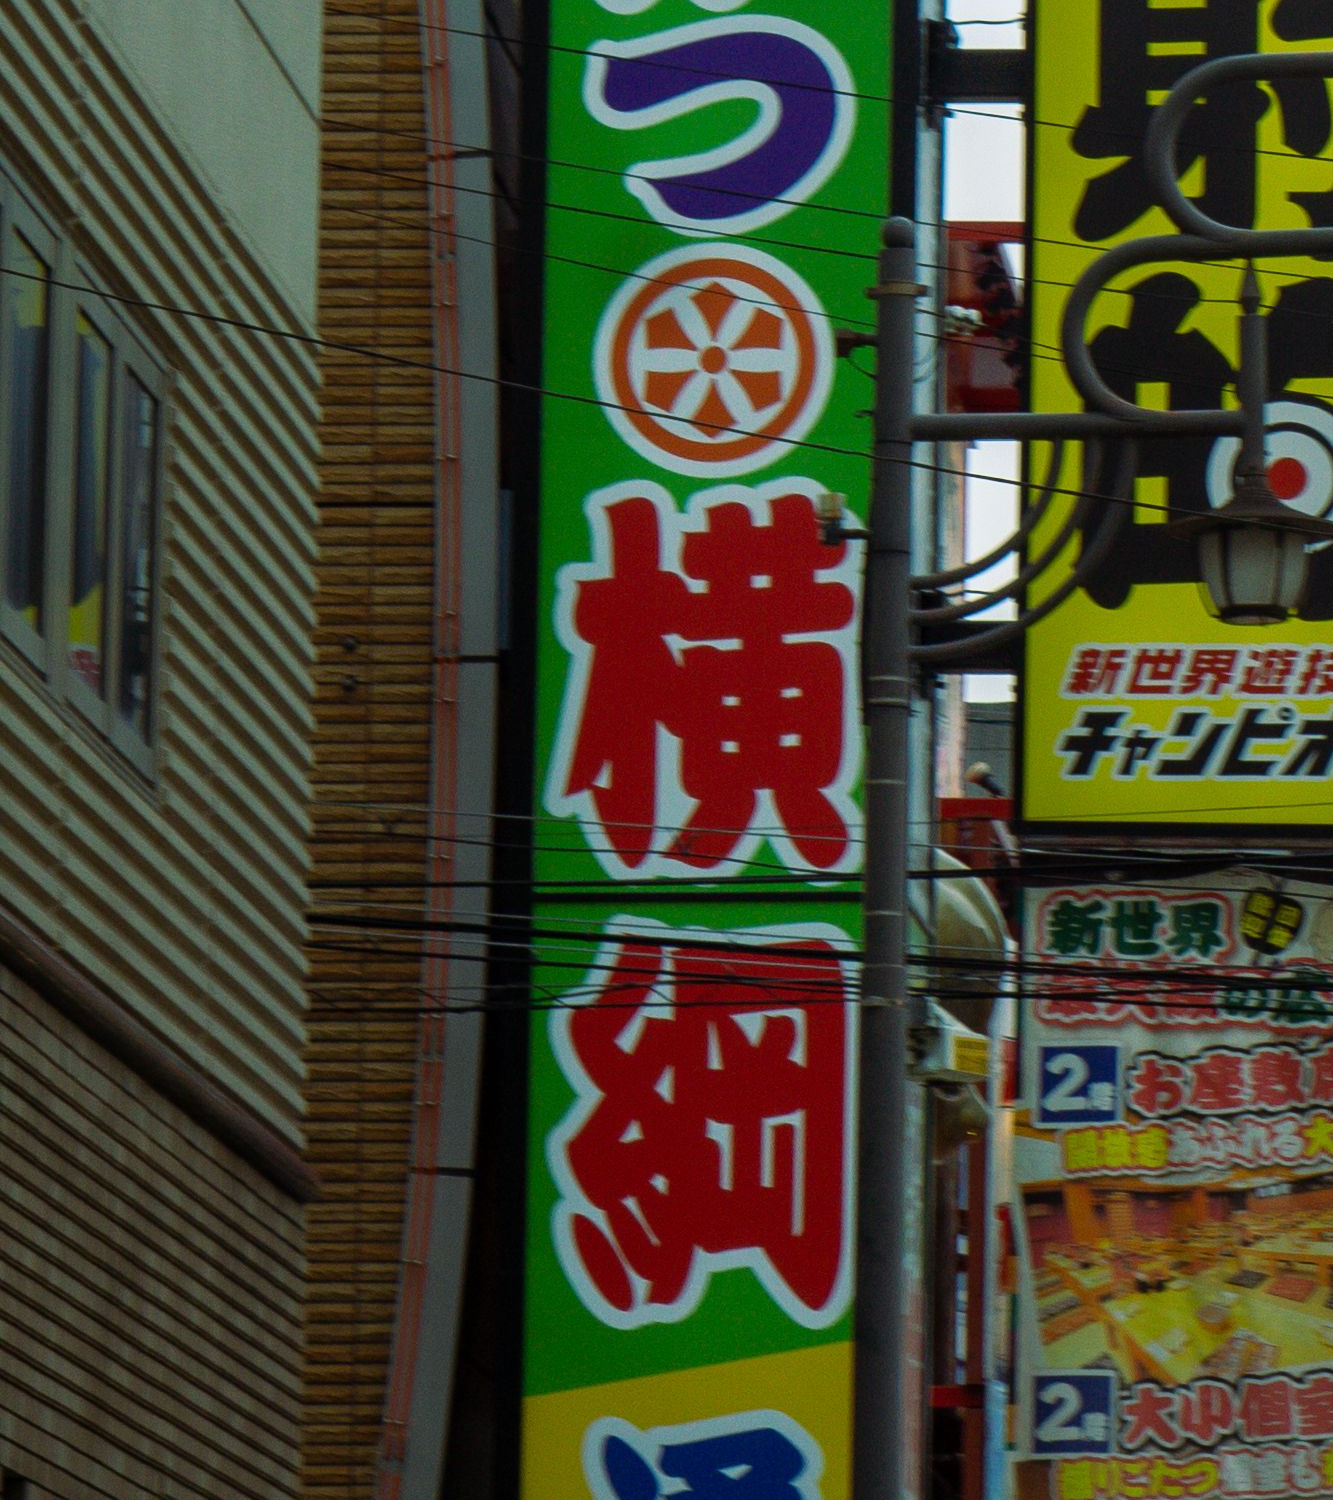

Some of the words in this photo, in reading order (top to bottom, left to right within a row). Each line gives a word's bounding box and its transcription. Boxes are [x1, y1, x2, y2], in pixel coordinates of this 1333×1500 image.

[566, 494, 855, 1311] 横綱
[1046, 898, 1230, 958] 新世界
